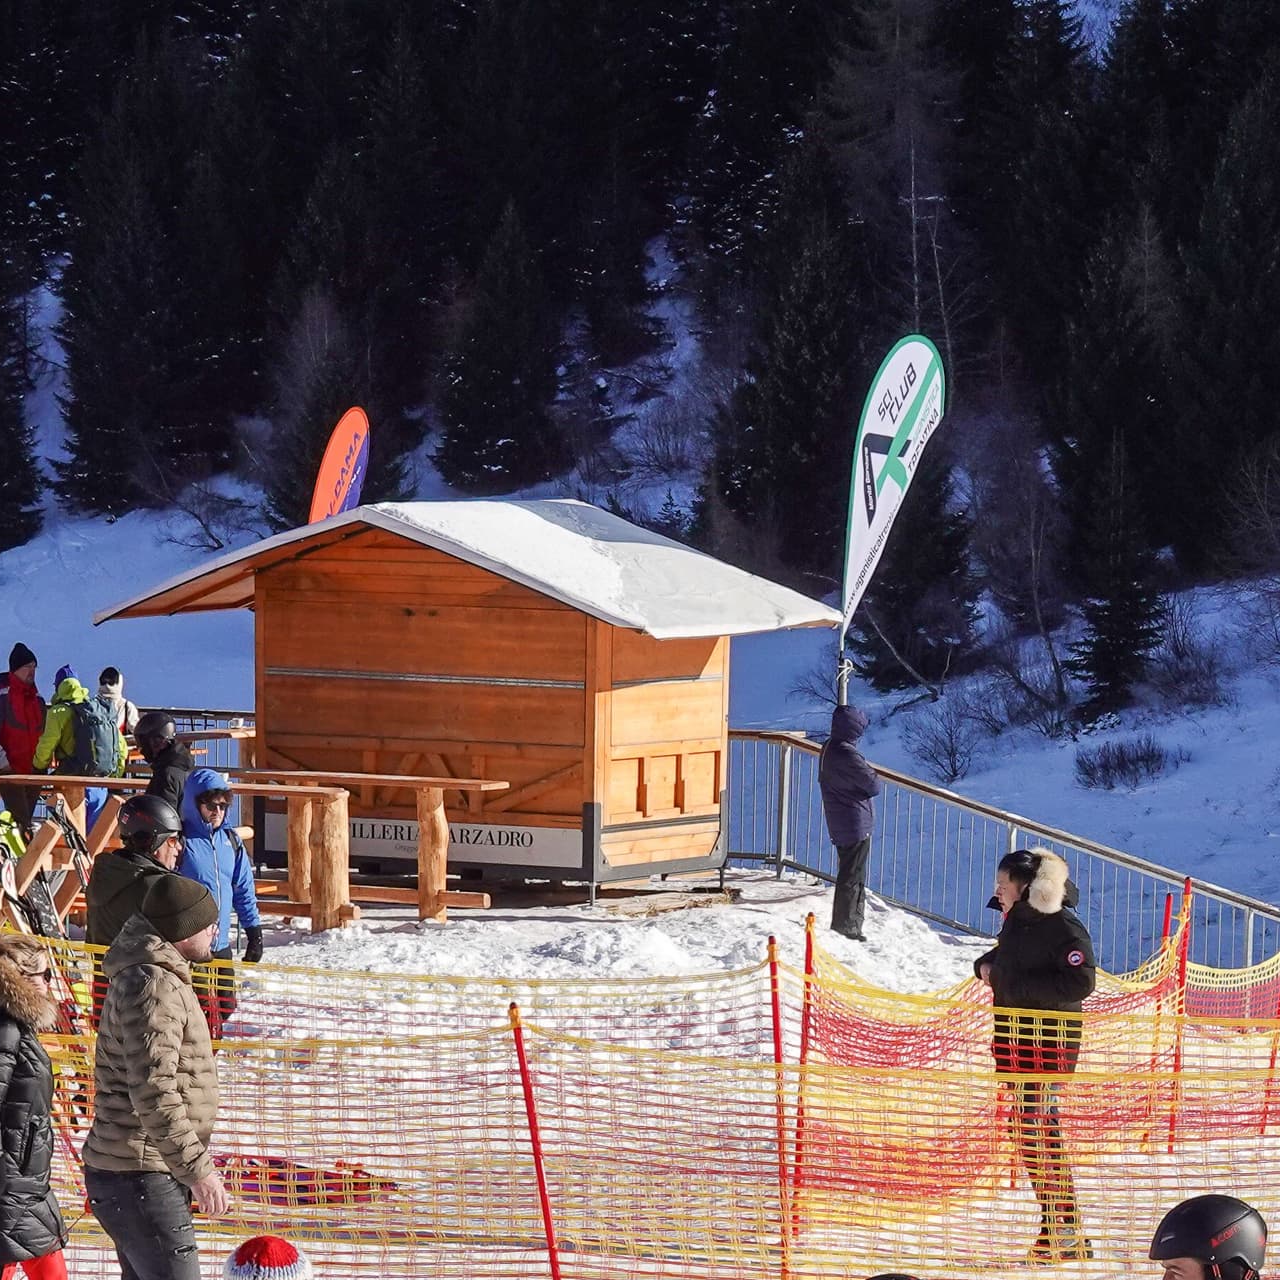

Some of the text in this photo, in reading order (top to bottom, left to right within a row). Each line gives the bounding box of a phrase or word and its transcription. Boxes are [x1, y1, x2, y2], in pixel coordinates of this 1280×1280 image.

[877, 388, 893, 422] SCI
[888, 362, 917, 424] CLUB
[351, 822, 534, 848] ILLERI ARZADRO
